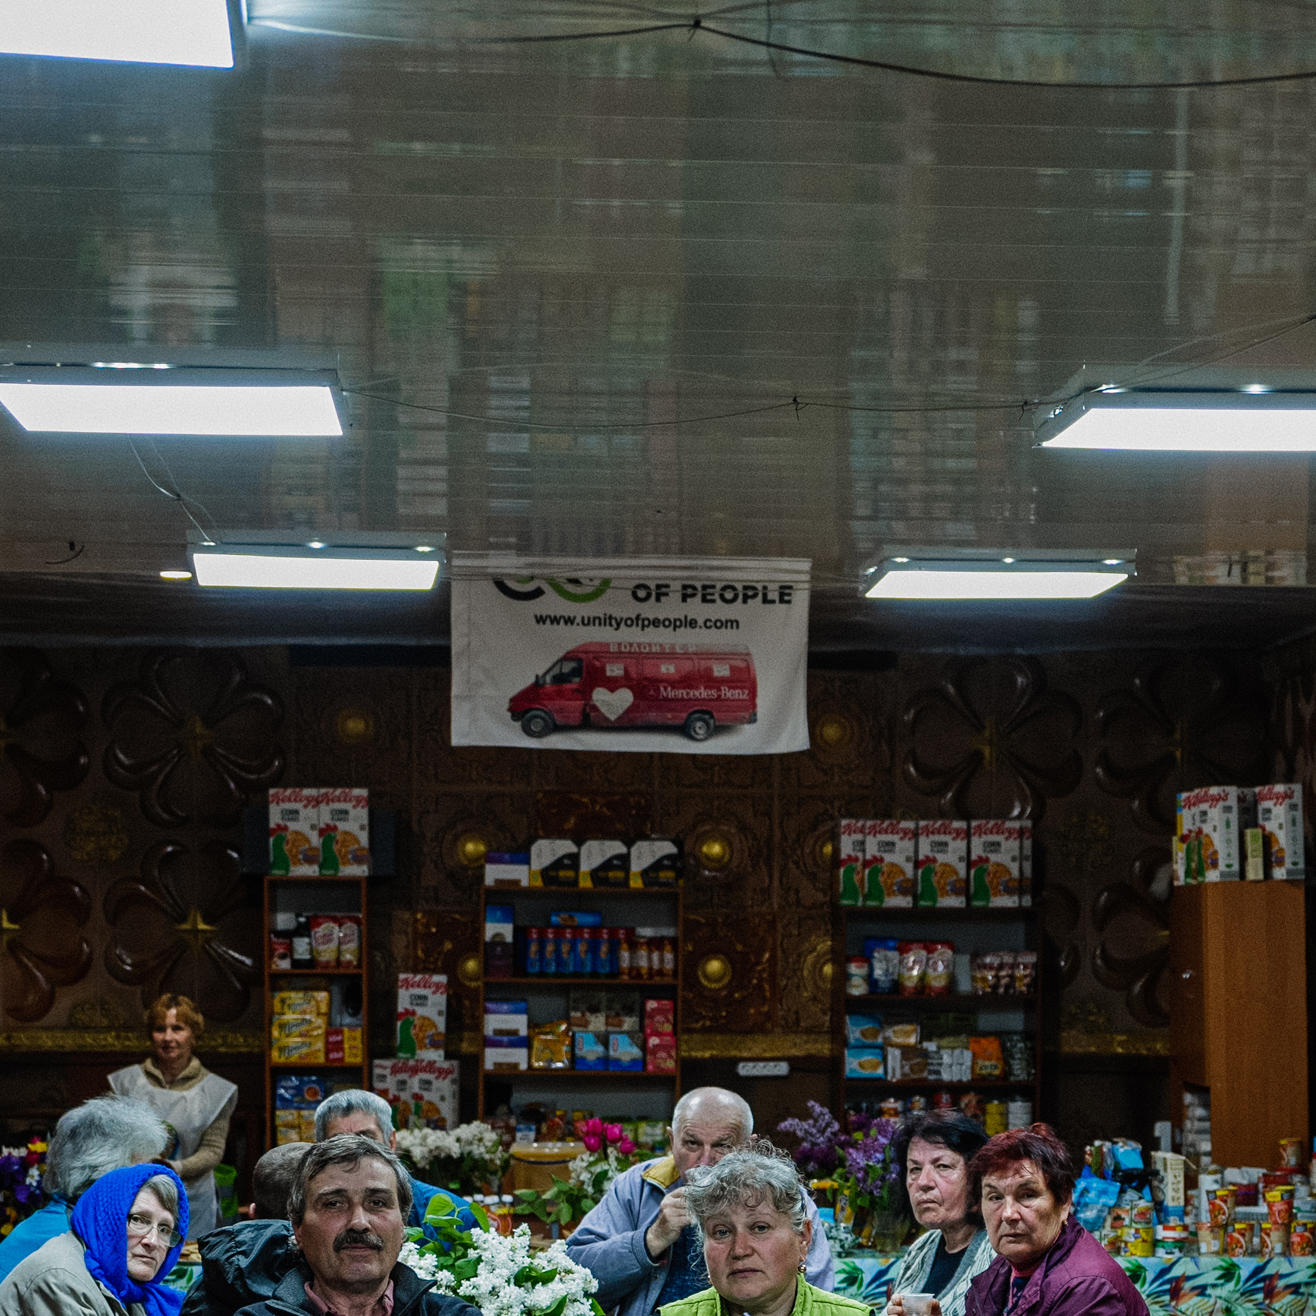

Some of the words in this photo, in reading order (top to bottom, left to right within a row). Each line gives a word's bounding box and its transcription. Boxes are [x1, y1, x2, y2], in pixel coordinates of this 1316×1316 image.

[631, 583, 671, 603] OF
[681, 584, 794, 604] PEOPLE
[534, 613, 740, 632] www.unityofpeople.com
[659, 686, 750, 701] Mercedes-Benz
